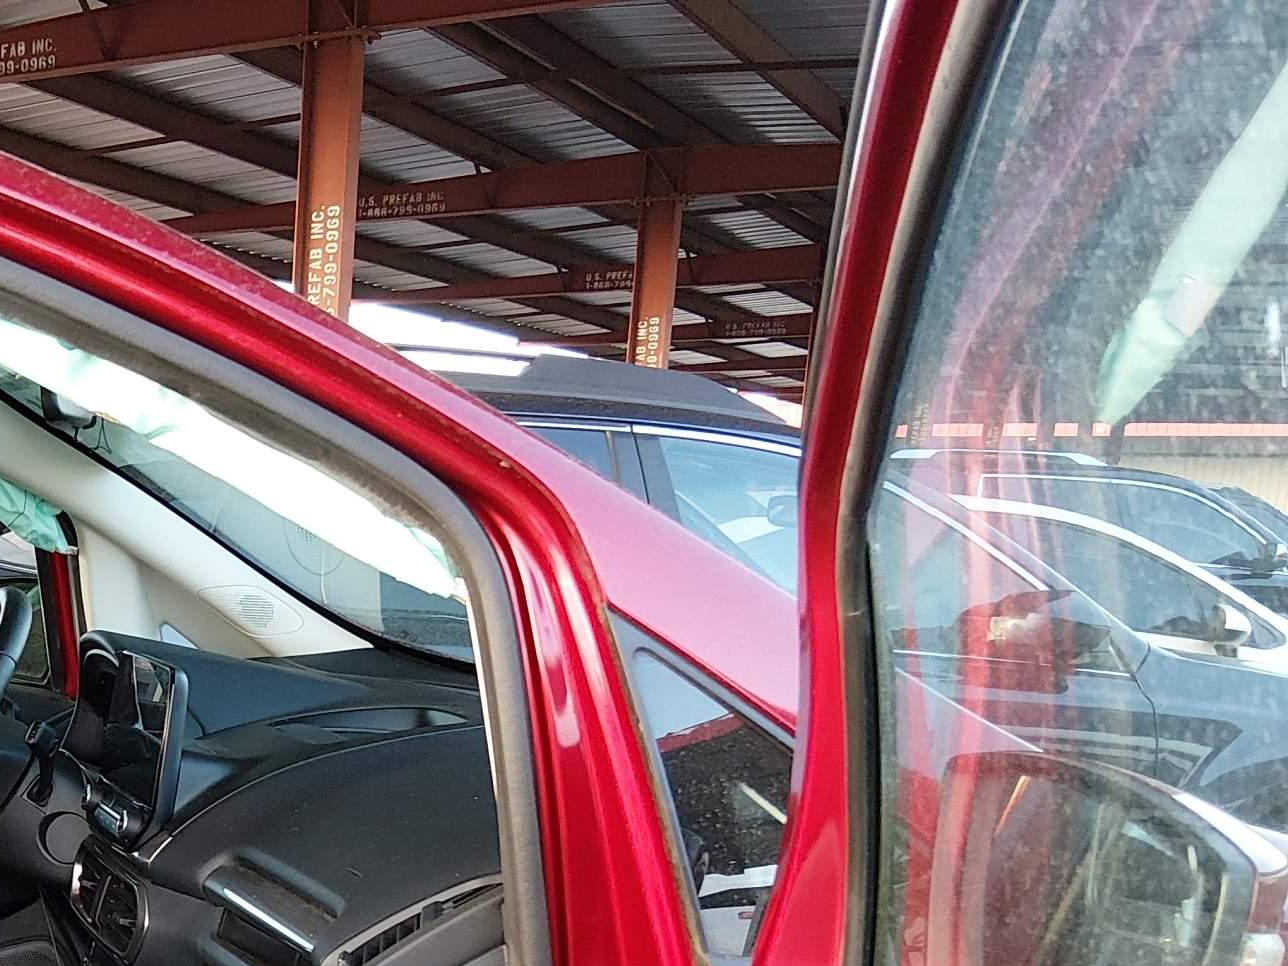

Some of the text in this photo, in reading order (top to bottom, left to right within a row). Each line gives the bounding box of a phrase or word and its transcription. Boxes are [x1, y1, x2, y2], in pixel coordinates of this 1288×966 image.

[32, 38, 56, 55] INC.
[383, 192, 422, 206] PREFAB
[310, 205, 325, 240] INC.
